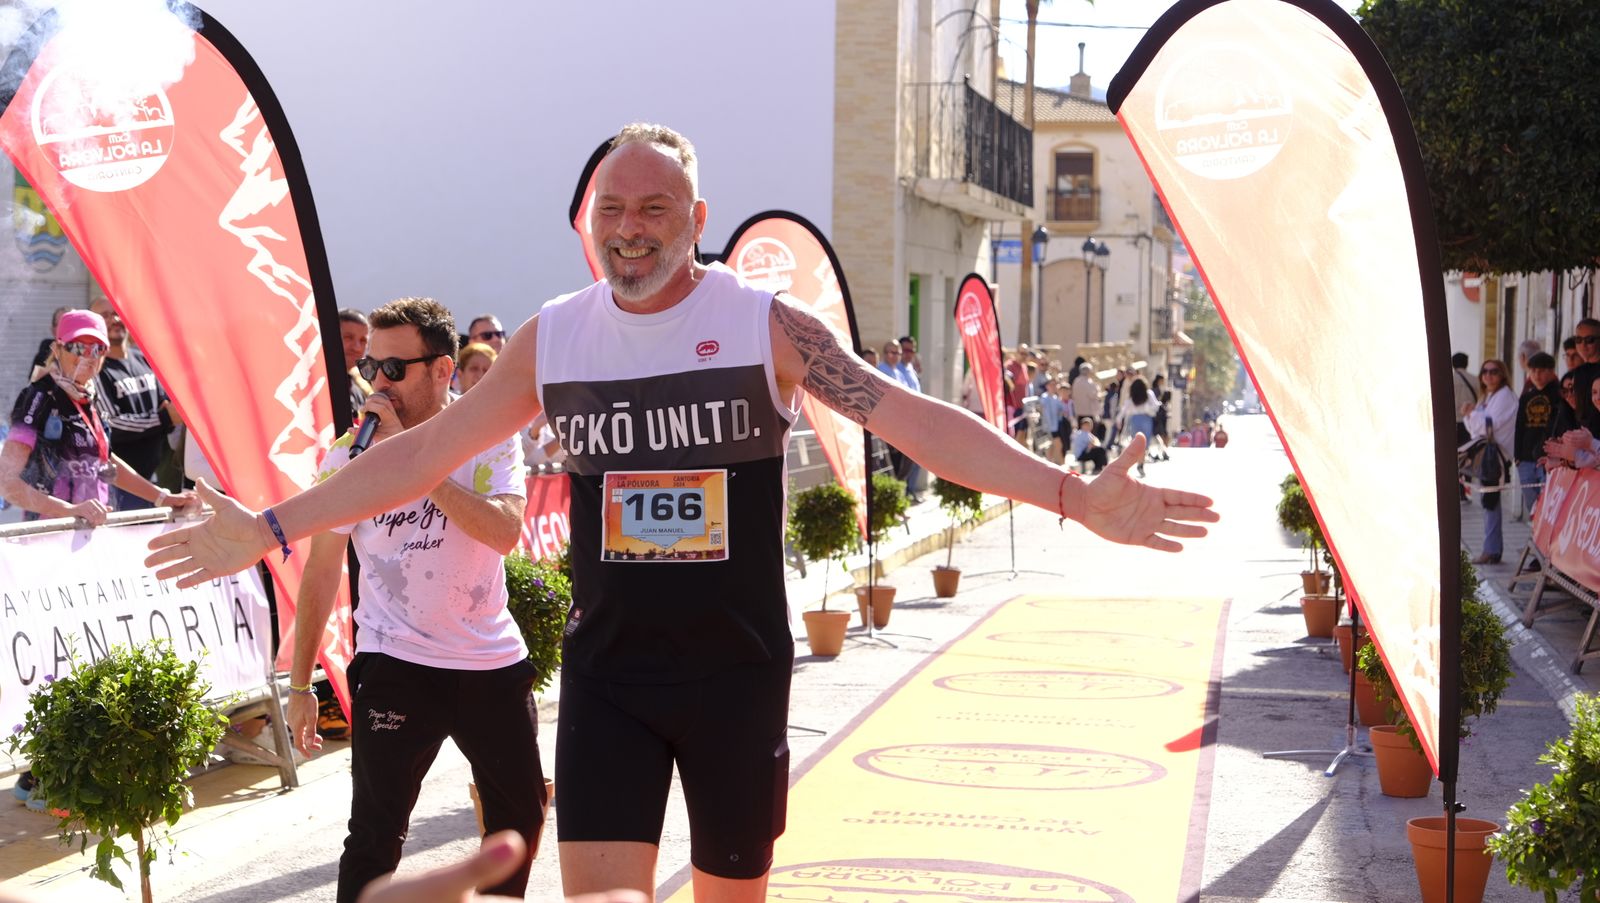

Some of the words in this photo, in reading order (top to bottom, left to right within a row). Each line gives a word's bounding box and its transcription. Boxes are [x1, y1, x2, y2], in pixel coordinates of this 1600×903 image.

[646, 398, 761, 451] UNLTD.
[625, 492, 702, 521] 166
[12, 597, 254, 686] CANTORIA
[842, 817, 1102, 836] Ayuntamiento
